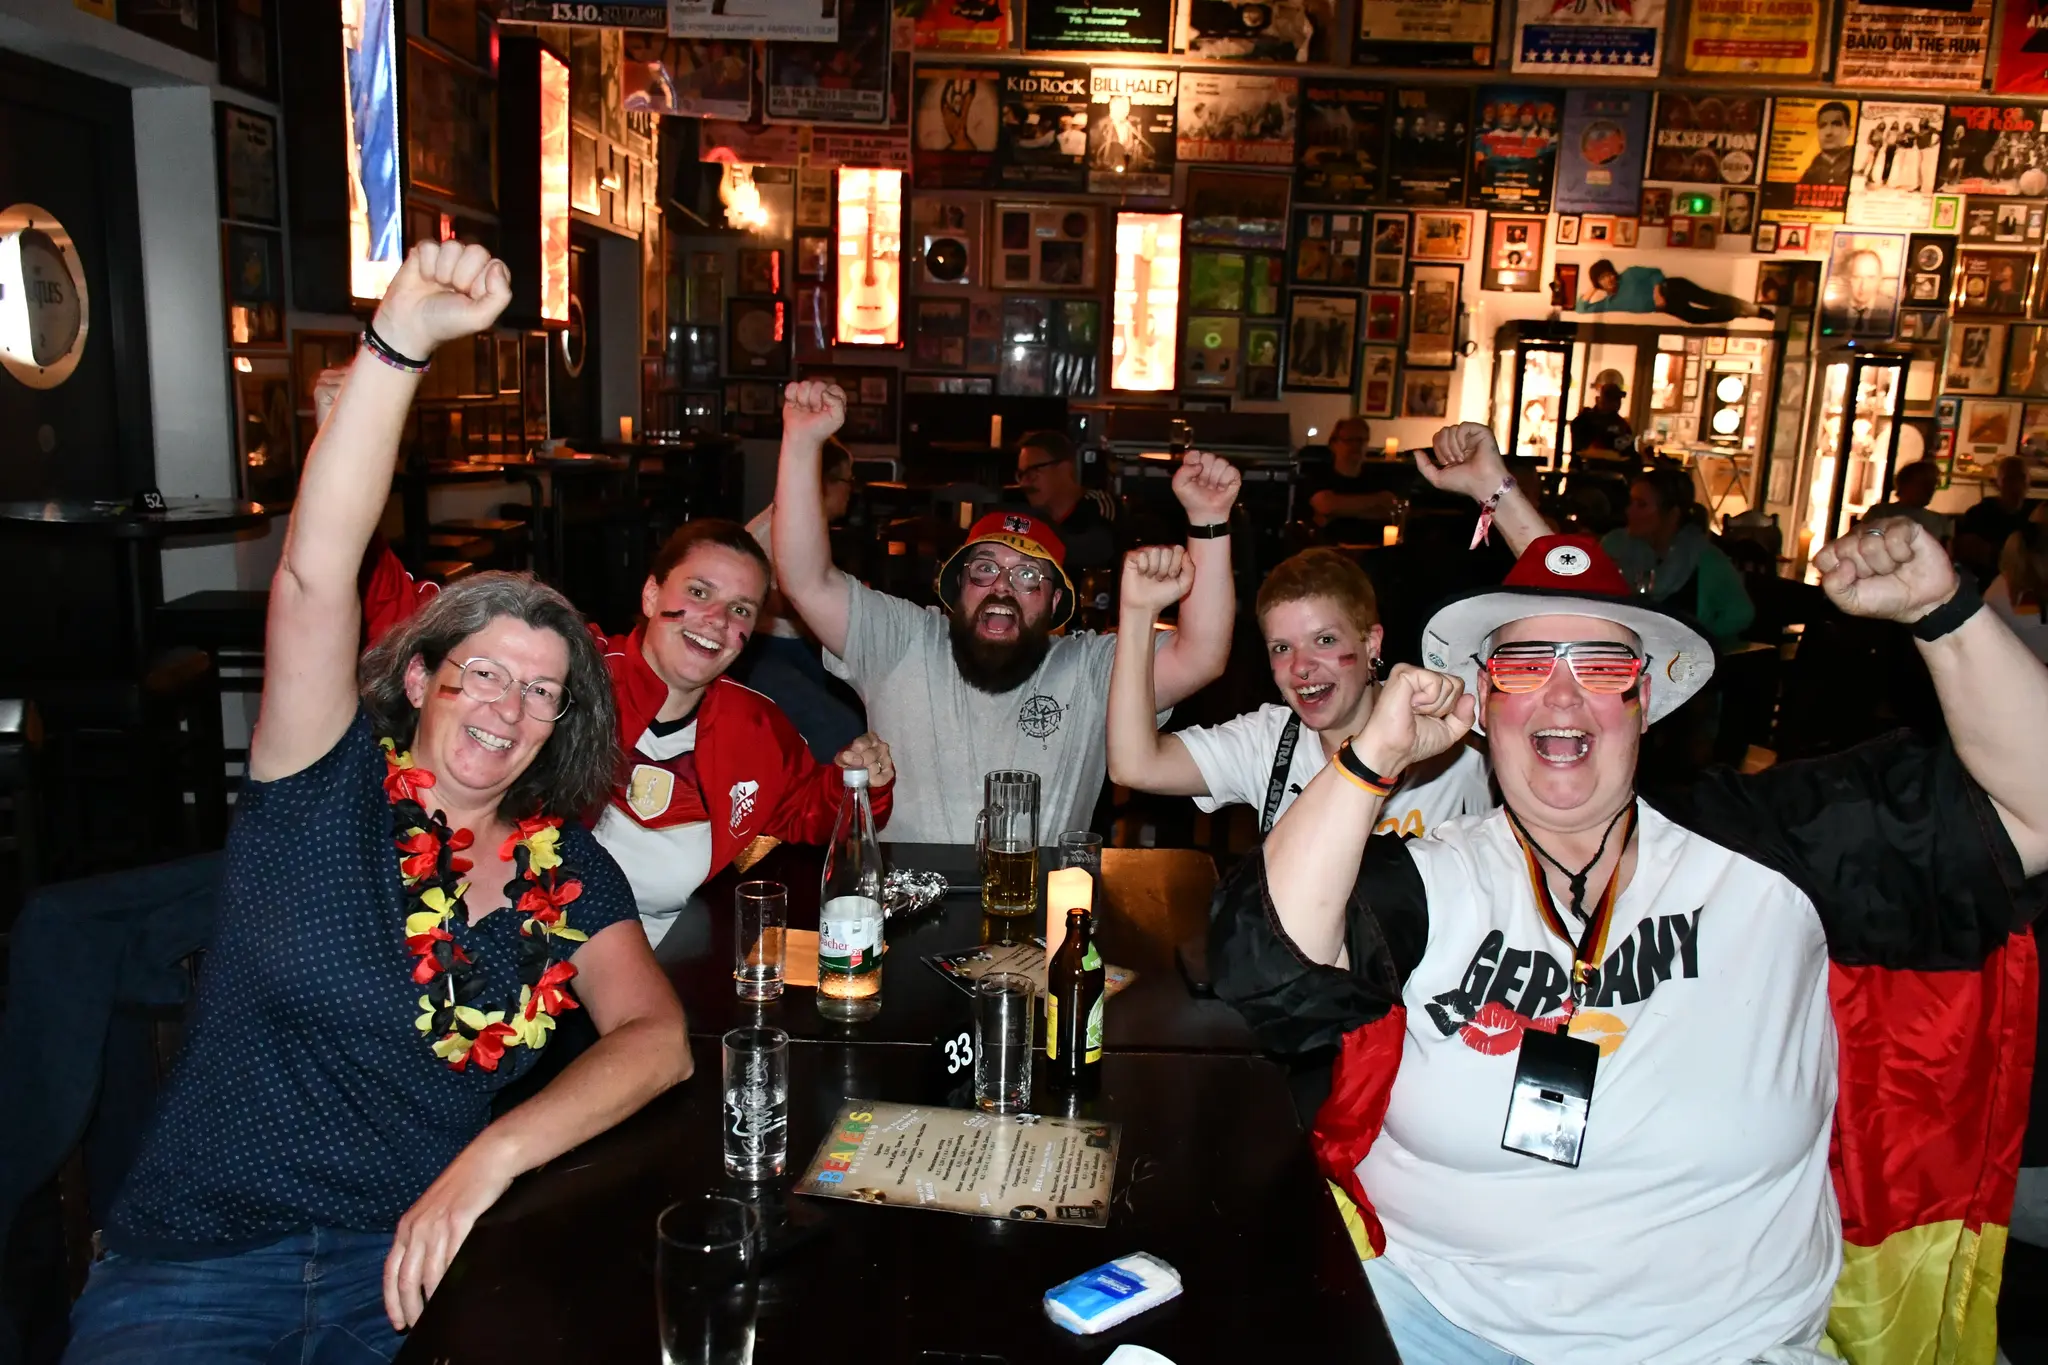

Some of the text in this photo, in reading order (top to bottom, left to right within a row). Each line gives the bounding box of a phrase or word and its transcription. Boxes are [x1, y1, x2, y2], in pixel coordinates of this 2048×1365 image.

[551, 3, 602, 21] 13.10.
[1845, 34, 1981, 54] BAND ON THE RUN
[1007, 76, 1086, 95] KID ROCK
[1093, 77, 1174, 94] BILL HALEY
[2003, 107, 2022, 118] OF
[1966, 117, 2035, 132] THE ROAD
[1657, 129, 1758, 151] EKSEPTION
[143, 492, 164, 509] 52
[1276, 722, 1299, 767] ASTRA
[944, 1032, 974, 1074] 33
[817, 1111, 873, 1184] BEAVERS
[848, 1124, 879, 1174] MUSIKCLUB
